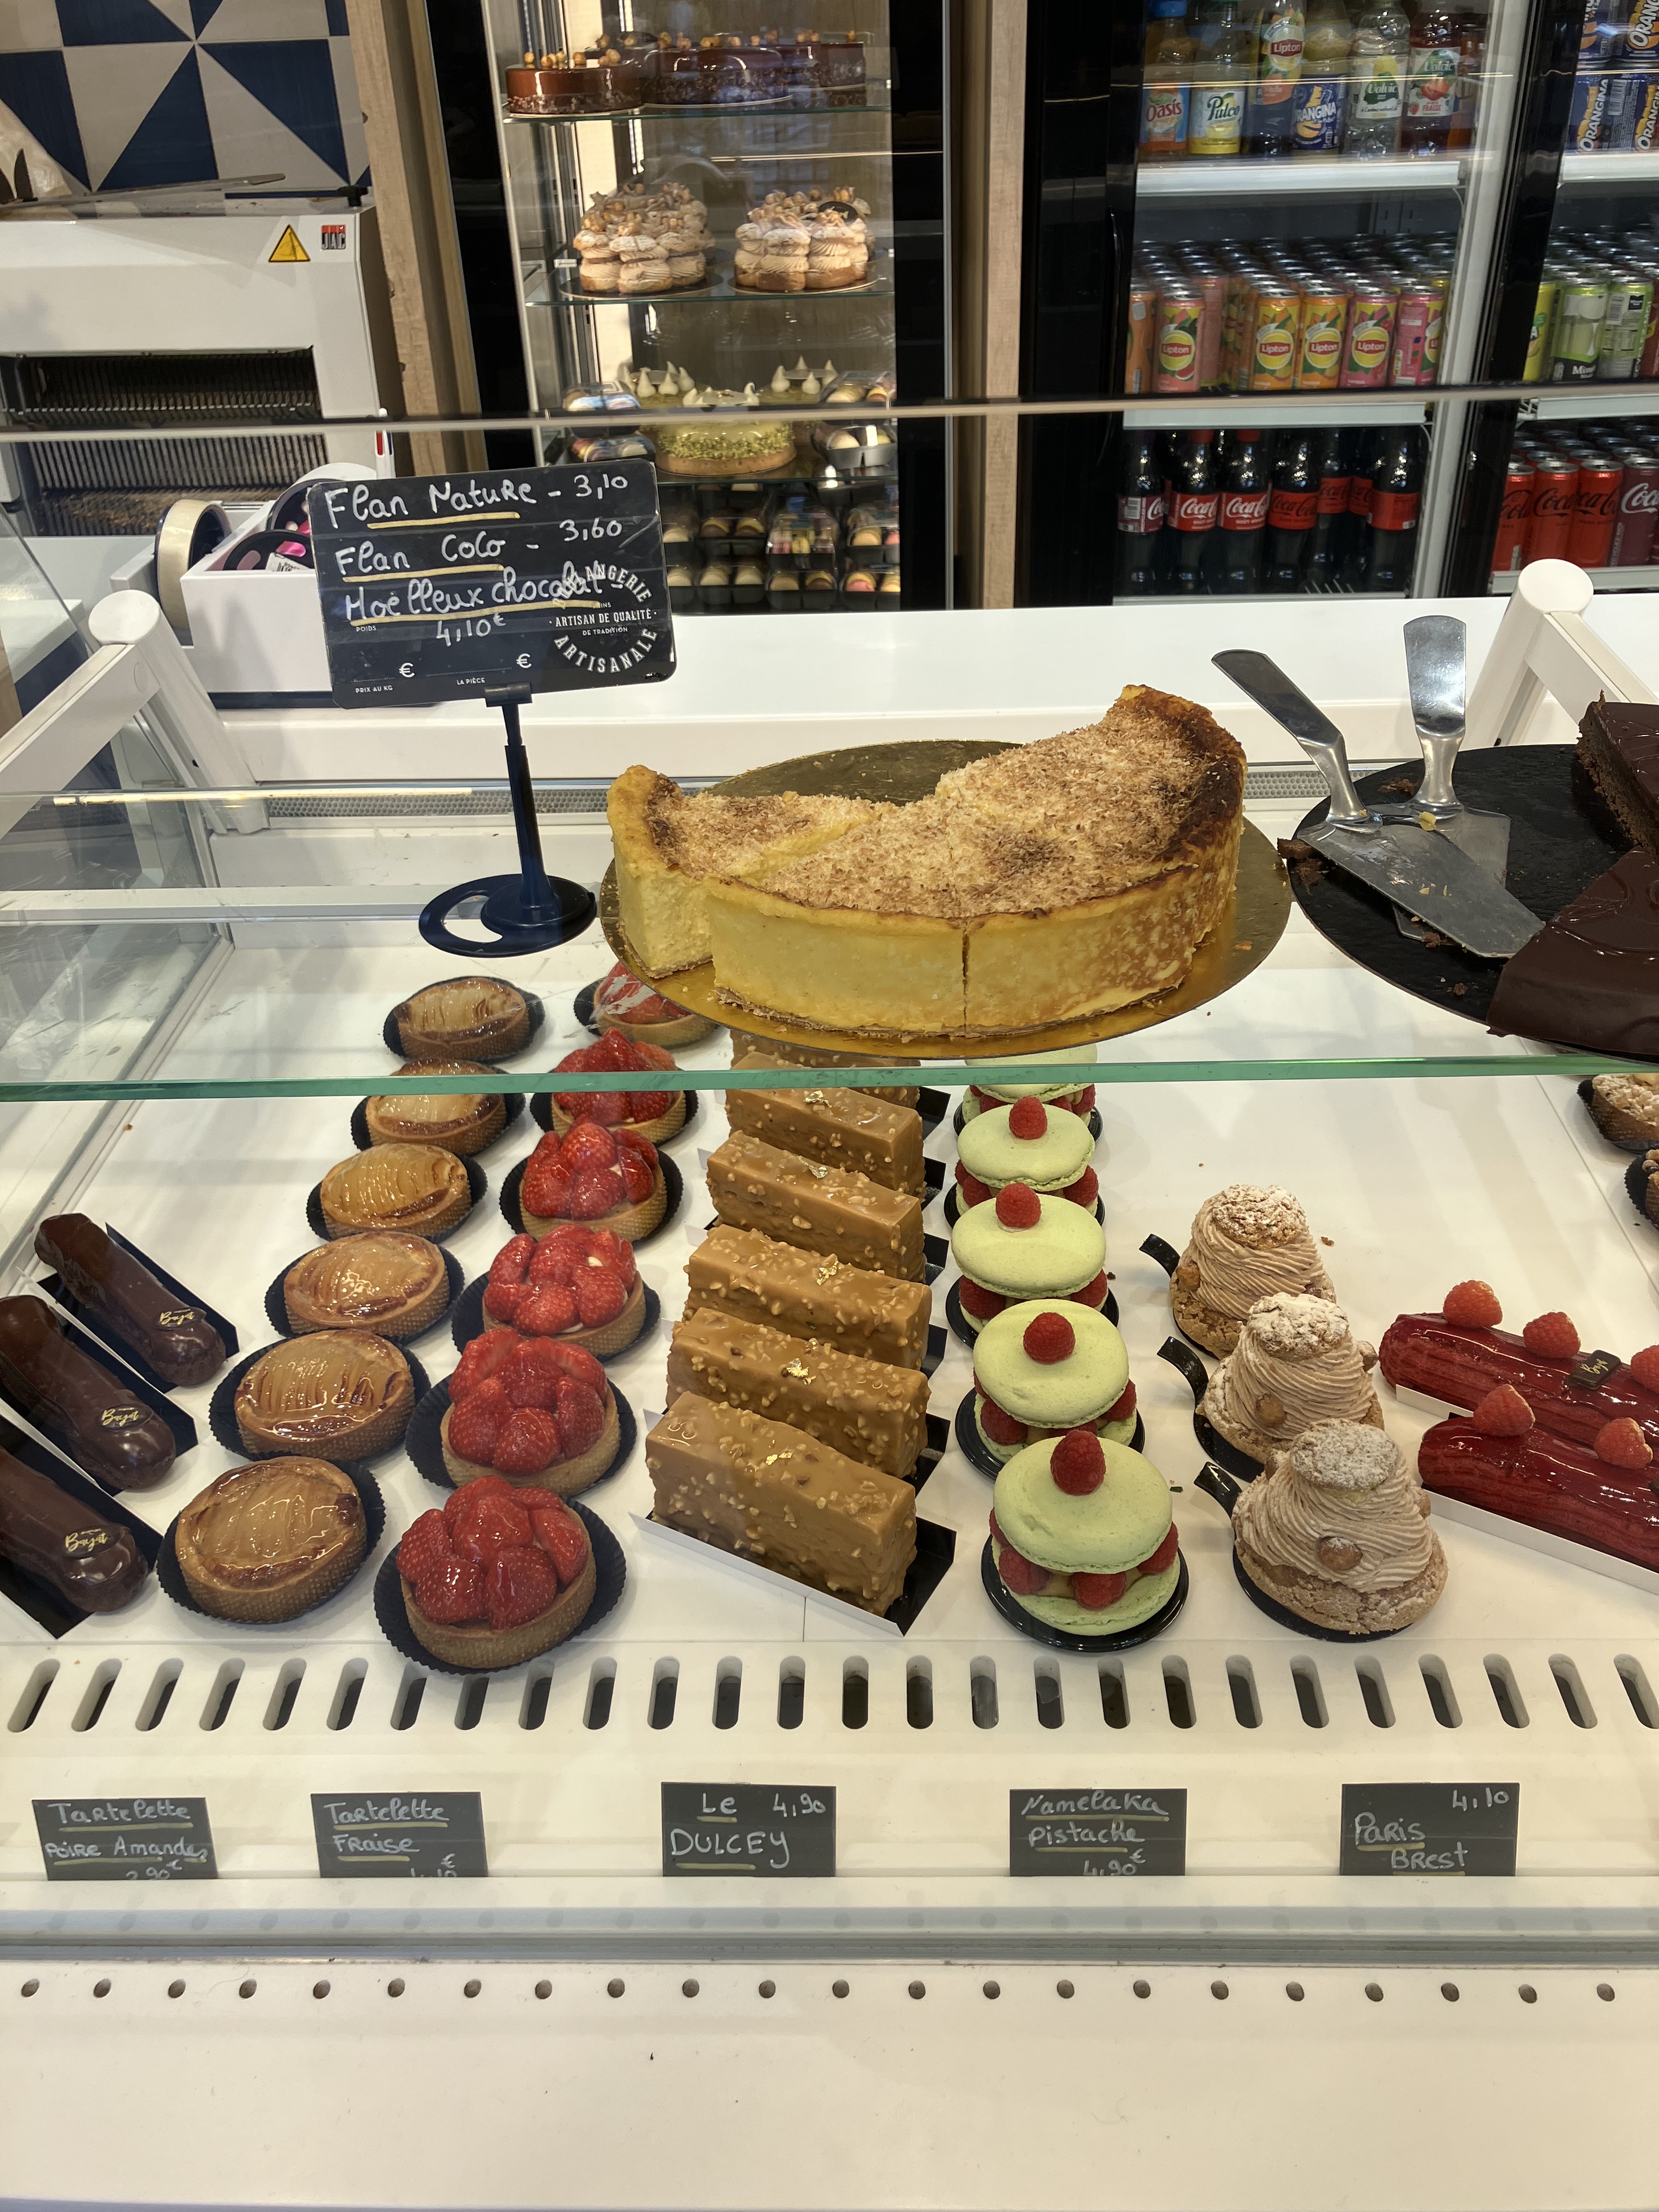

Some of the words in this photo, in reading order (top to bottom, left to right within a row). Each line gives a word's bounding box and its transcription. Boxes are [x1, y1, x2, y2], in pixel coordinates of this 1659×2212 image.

[1273, 43, 1301, 54] Lipton
[1368, 82, 1397, 94] Volvic
[1146, 99, 1183, 122] Oasis
[1207, 96, 1240, 121] Pulco
[1296, 102, 1336, 122] RANGINA
[1579, 79, 1609, 151] ORANGINA
[321, 233, 346, 250] JAC
[1163, 345, 1190, 354] Lipton
[1261, 344, 1289, 354] Lipton
[1311, 343, 1338, 353] Lipton
[1357, 341, 1385, 352] Lipton
[324, 484, 409, 529] Flan
[574, 473, 628, 500] 3,10
[335, 540, 410, 575] Flan
[559, 517, 623, 541] 3,60
[555, 614, 595, 627] ARTISAN
[599, 612, 610, 623] DE
[613, 608, 652, 623] QUALITÉ
[593, 627, 628, 635] TRADITION
[554, 628, 658, 673] ARTISANALE
[516, 653, 532, 669] €
[399, 662, 415, 678] €
[702, 1792, 737, 1814] Le
[772, 1793, 827, 1818] 4,90
